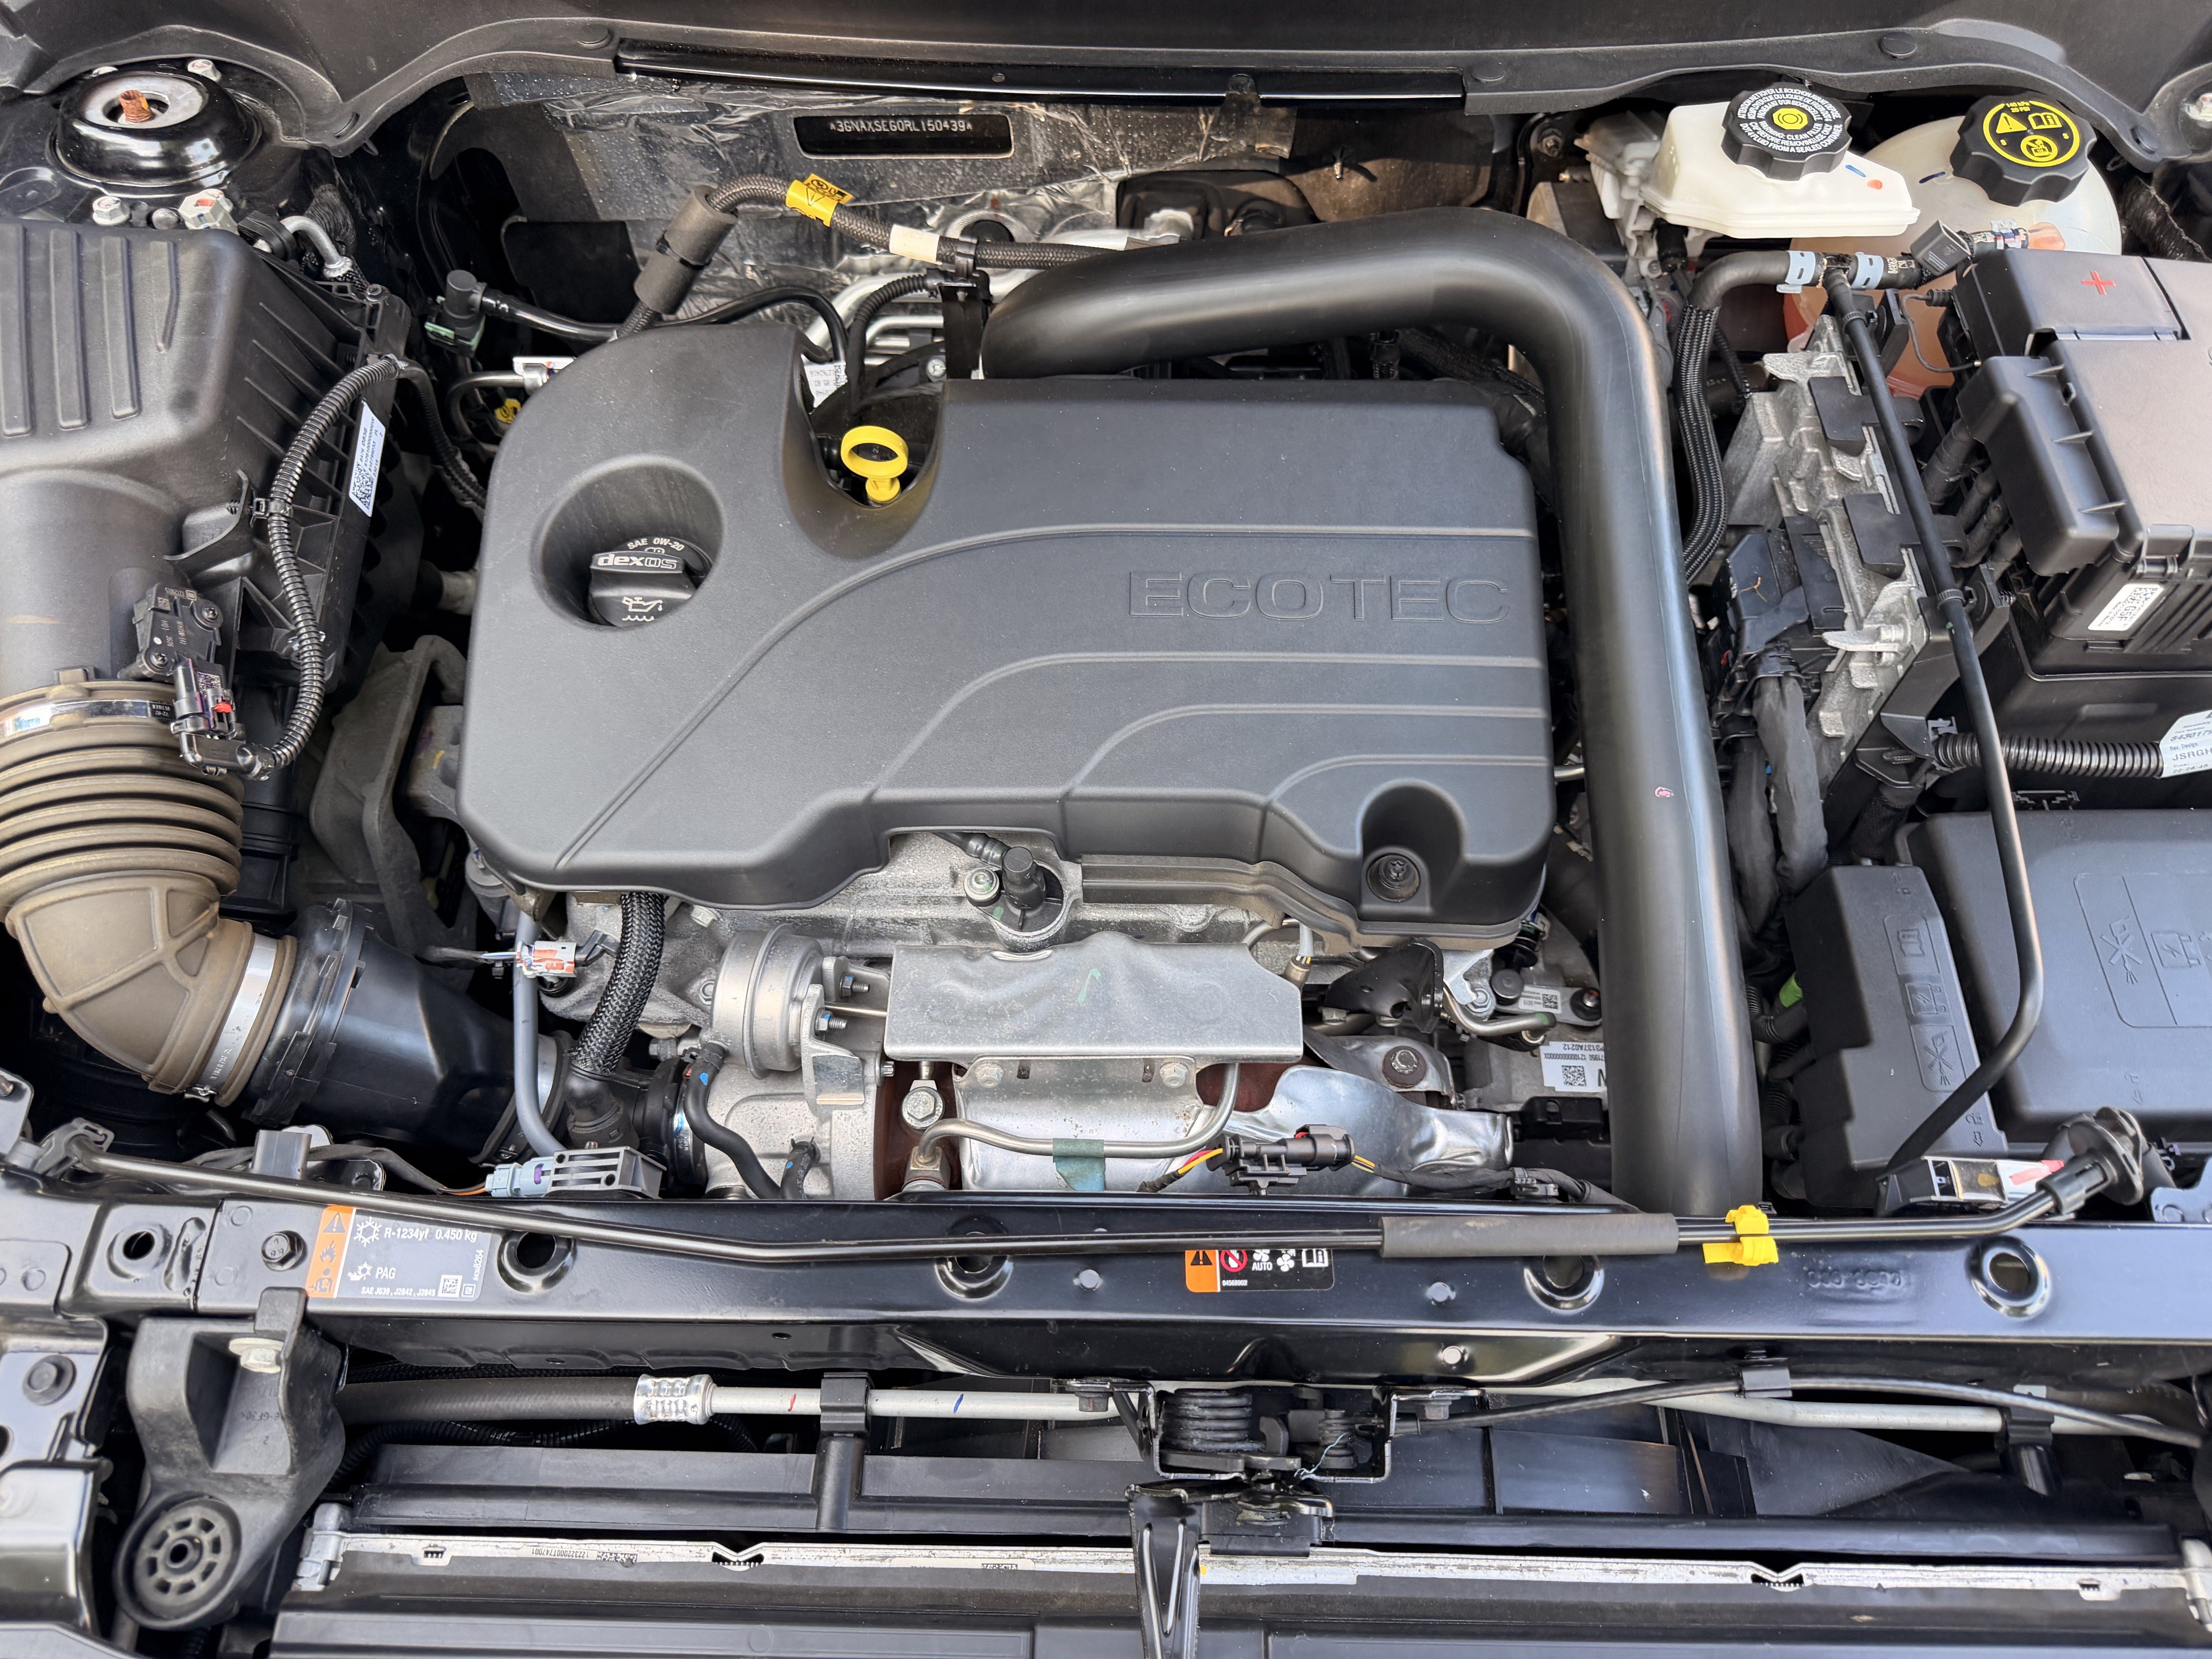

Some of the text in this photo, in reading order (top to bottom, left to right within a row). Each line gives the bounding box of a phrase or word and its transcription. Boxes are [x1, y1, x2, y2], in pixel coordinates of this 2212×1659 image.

[1749, 122, 1760, 131] CAP
[1757, 129, 1781, 144] BEFORE
[1807, 123, 1823, 137] FILLER
[1750, 134, 1769, 146] FLUID
[1769, 142, 1789, 152] FROM
[1796, 143, 1822, 153] SEALED
[627, 538, 685, 551] SAE 0W-20
[598, 554, 677, 569] dexos
[1129, 572, 1510, 623] ECOTEC
[384, 1227, 477, 1242] R-1234yf 0.450 kg
[375, 1267, 397, 1279] PAG
[1252, 1262, 1272, 1271] AUTO
